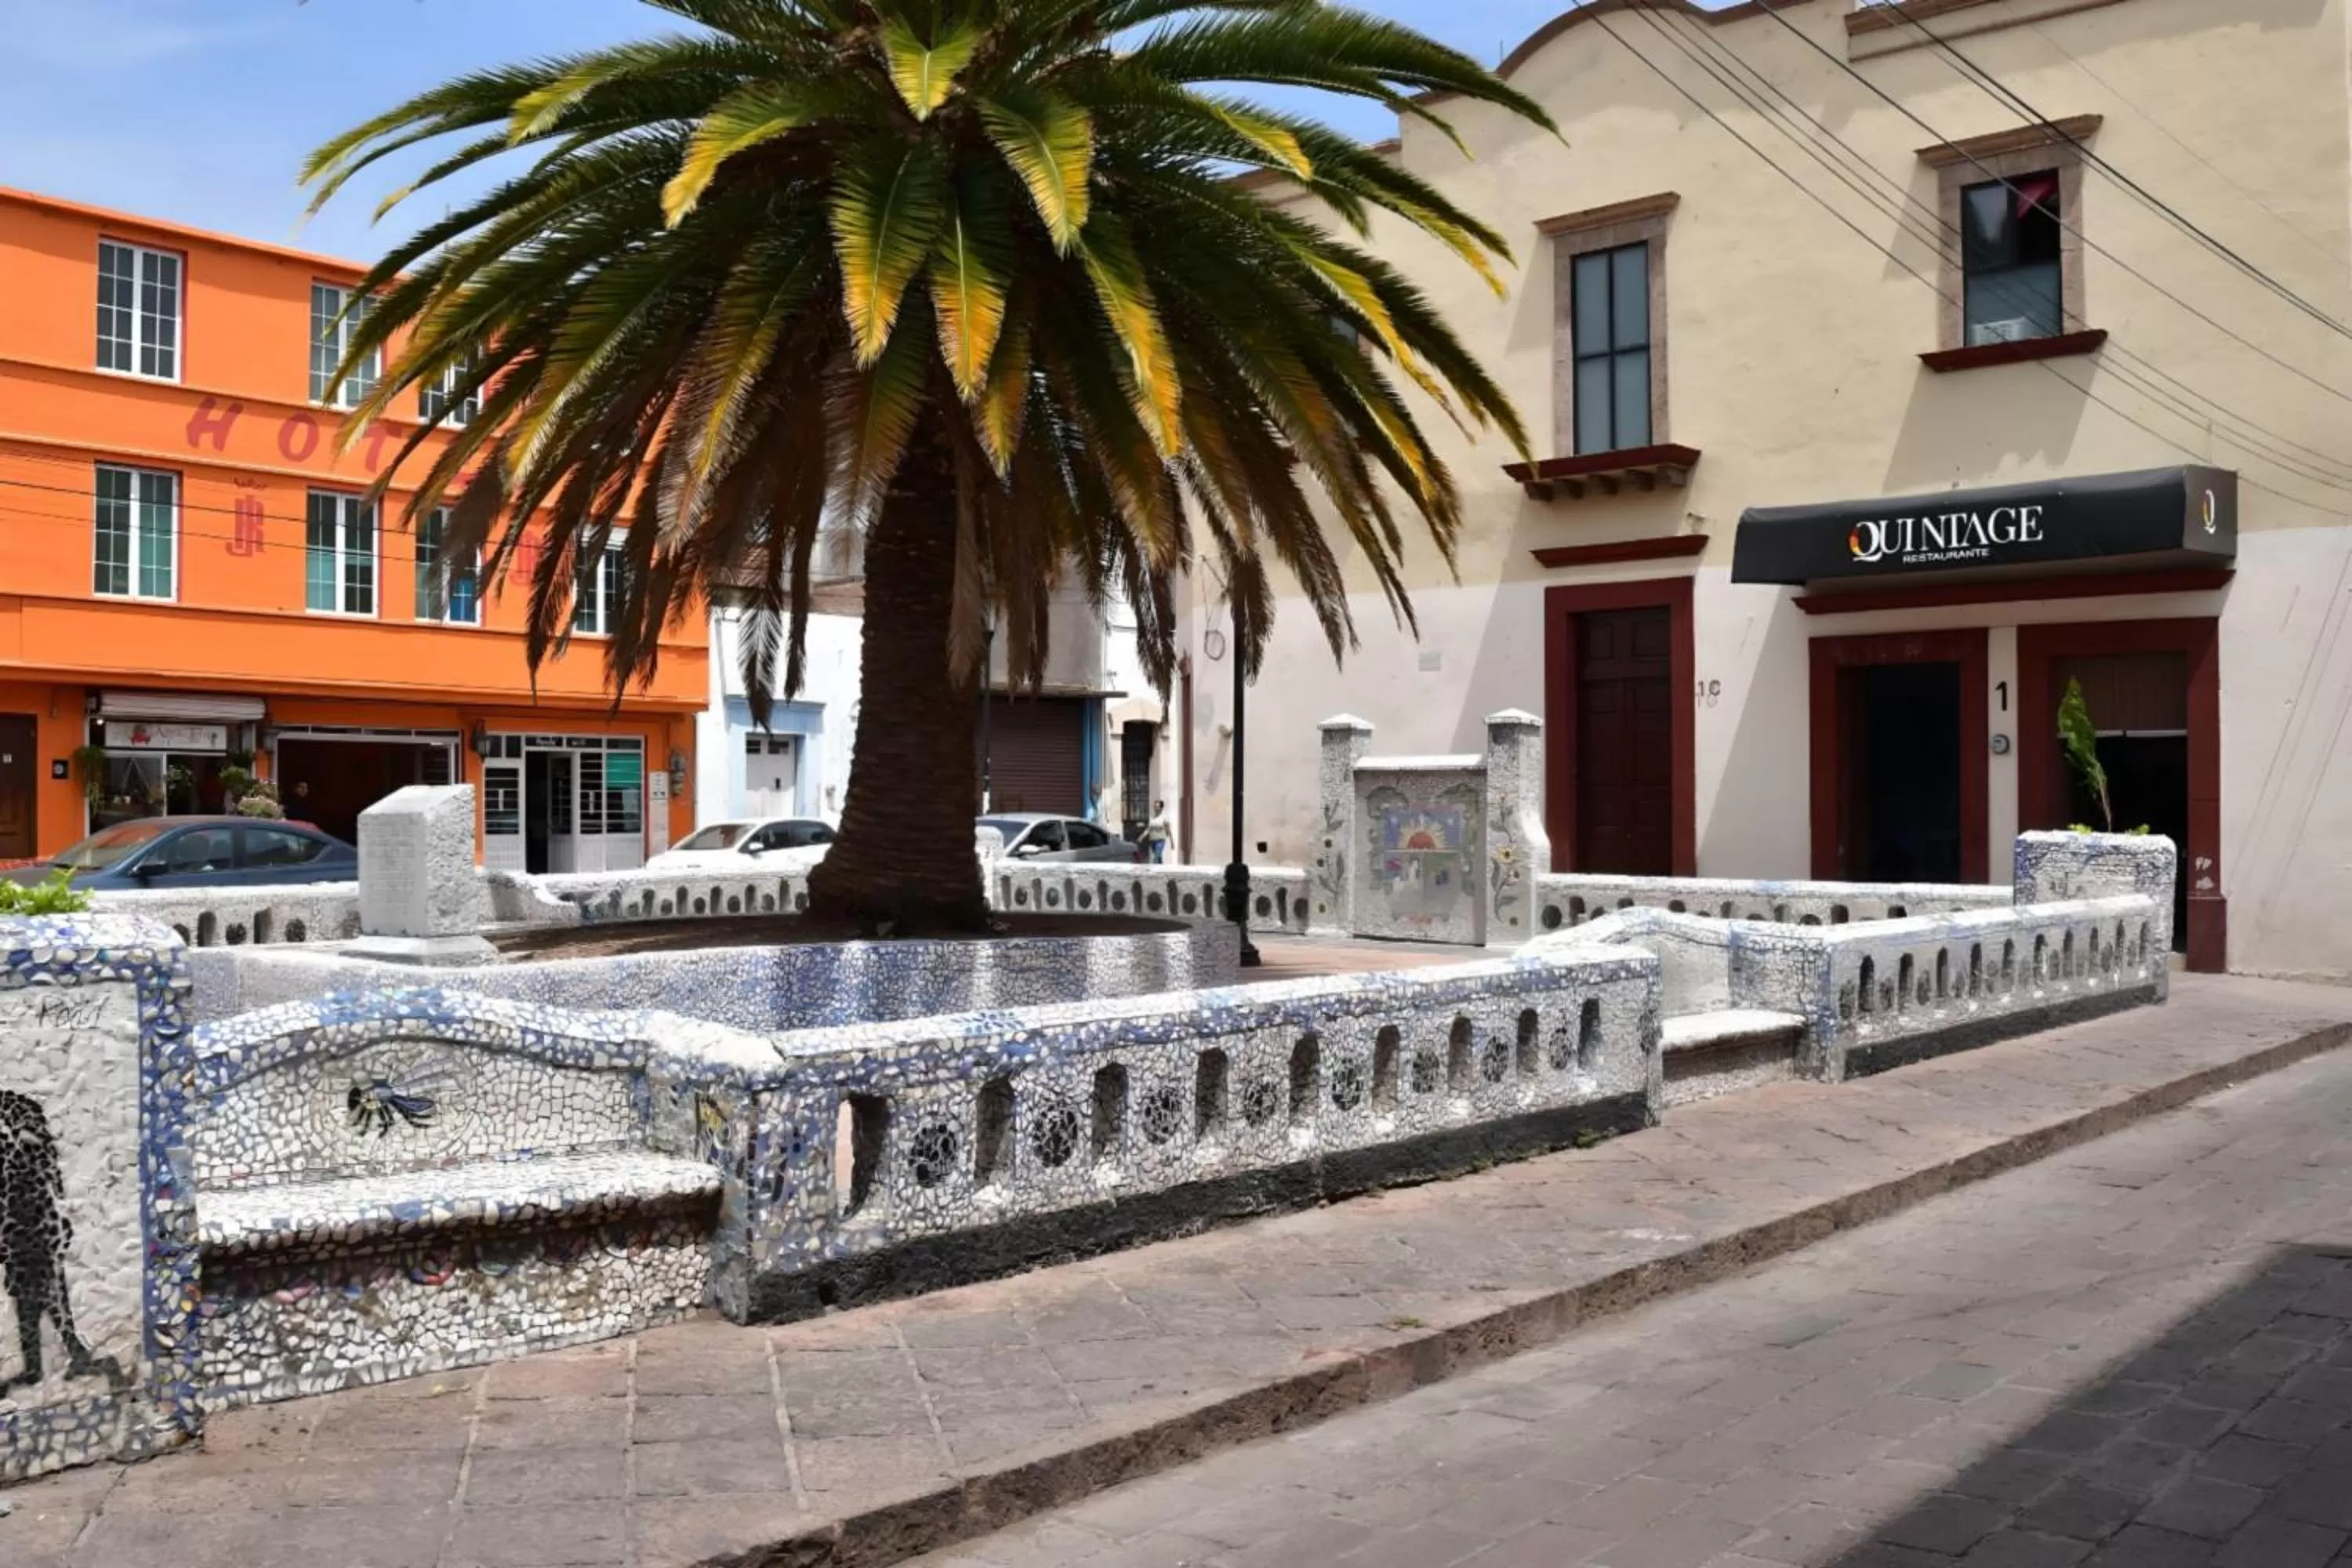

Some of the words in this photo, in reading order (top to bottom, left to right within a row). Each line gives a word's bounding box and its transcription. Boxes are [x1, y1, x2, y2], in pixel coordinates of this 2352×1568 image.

[186, 394, 478, 488] HOT
[1848, 505, 2043, 561] QUINTAGE
[1903, 548, 1990, 564] RESTAURANTE
[1994, 680, 2008, 711] 1
